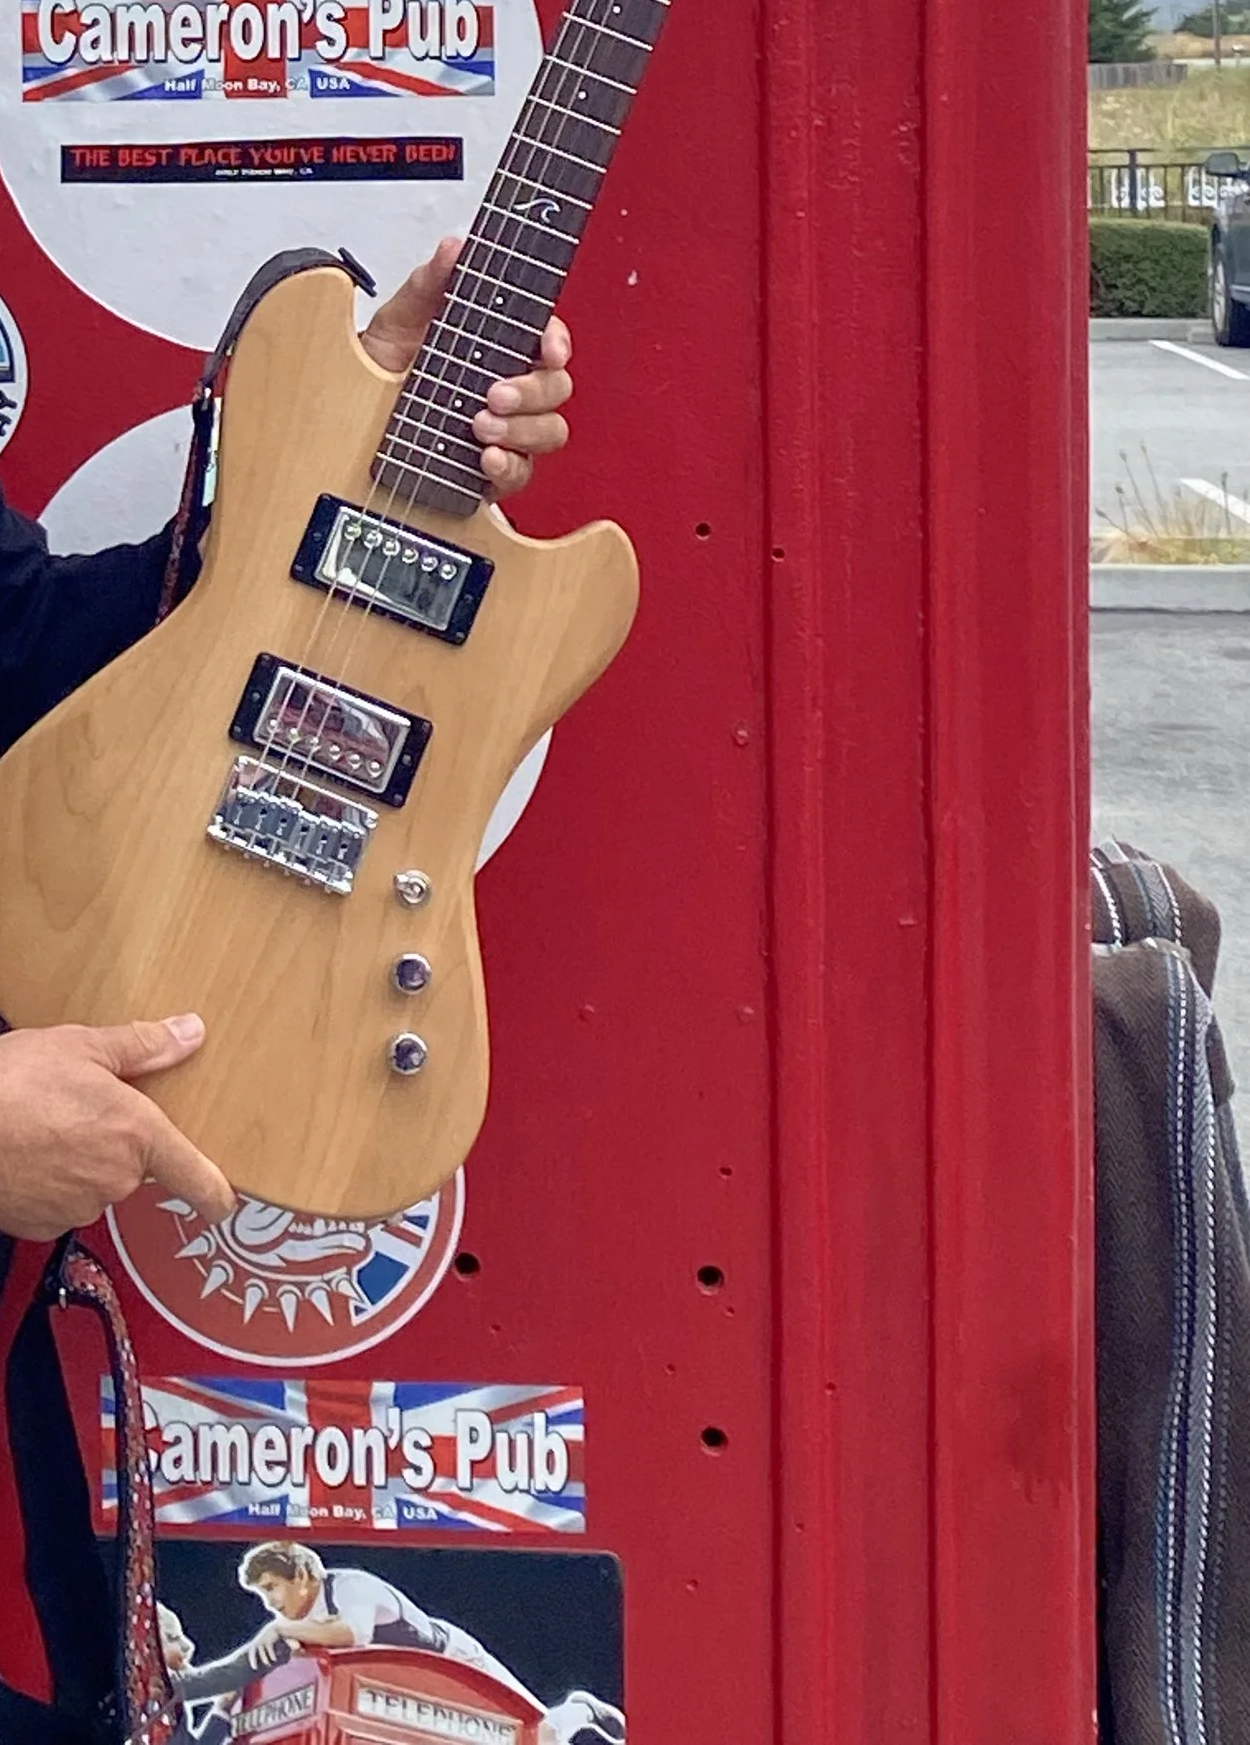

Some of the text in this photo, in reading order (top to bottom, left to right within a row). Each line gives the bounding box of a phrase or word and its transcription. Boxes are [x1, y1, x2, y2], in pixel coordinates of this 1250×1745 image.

[164, 78, 198, 92] Half
[203, 78, 244, 92] Moon
[247, 78, 282, 93] Bay,
[316, 77, 351, 91] USA
[70, 148, 111, 168] THE
[117, 148, 173, 167] BEST
[179, 147, 243, 168] PLACE
[250, 145, 325, 166] YOU'VE
[332, 144, 398, 164] NEVER
[454, 1408, 571, 1495] Pub
[248, 1504, 282, 1517] Half
[287, 1505, 329, 1518] Moon
[333, 1505, 367, 1520] Bay,
[403, 1506, 439, 1521] USA
[234, 1689, 312, 1735] TELEPHONE
[364, 1688, 518, 1744] TELEPHONE
